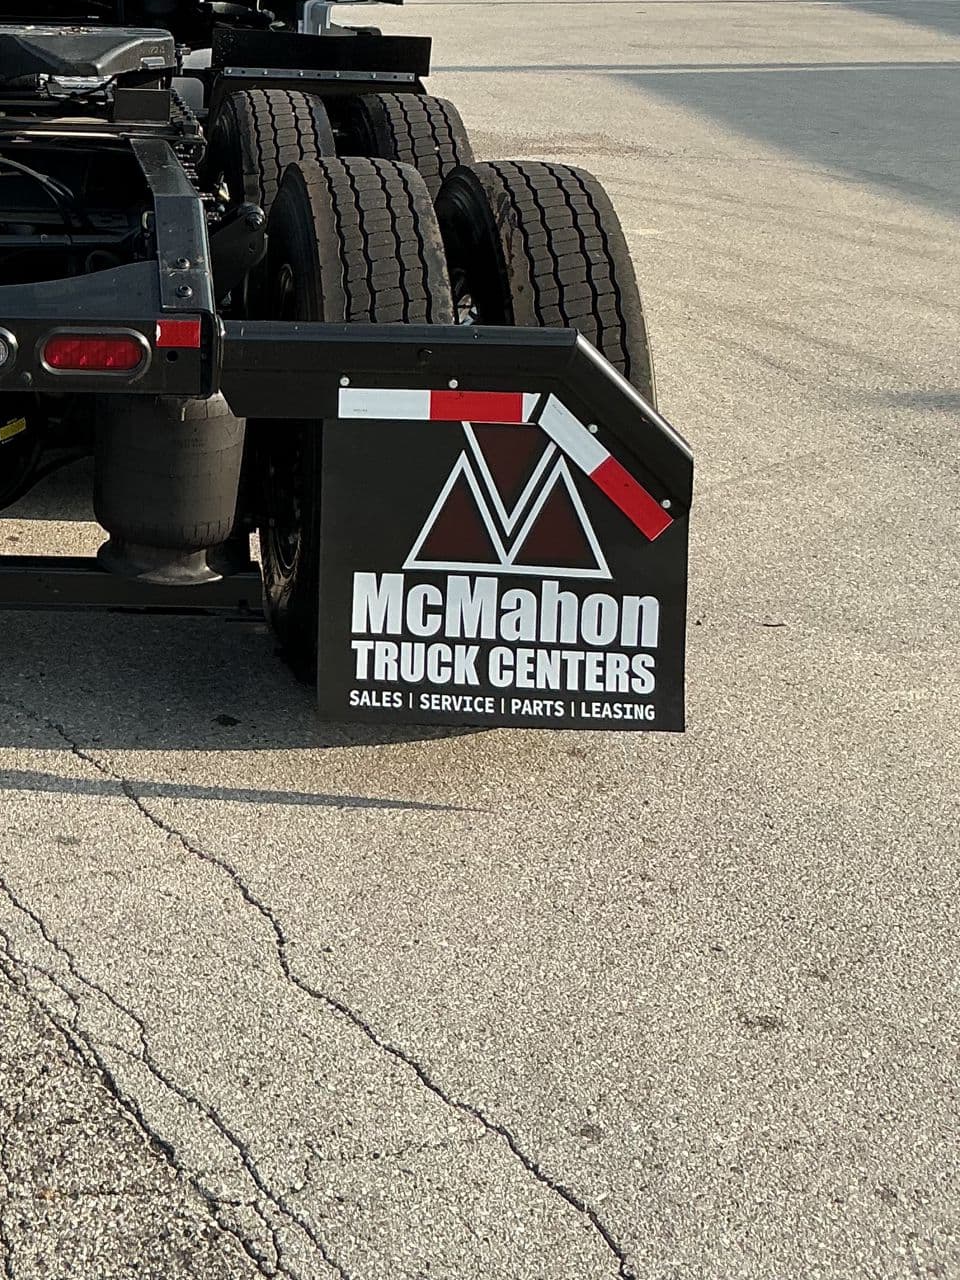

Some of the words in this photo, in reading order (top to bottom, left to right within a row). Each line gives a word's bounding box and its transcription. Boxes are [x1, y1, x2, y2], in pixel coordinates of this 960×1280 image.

[351, 572, 660, 648] McMahon
[351, 640, 480, 686] TRUCK
[489, 647, 656, 695] CENTERS
[349, 689, 403, 708] SALES
[419, 693, 495, 714] SERVICE
[511, 698, 565, 718] PARTS
[580, 701, 656, 721] LEASING
